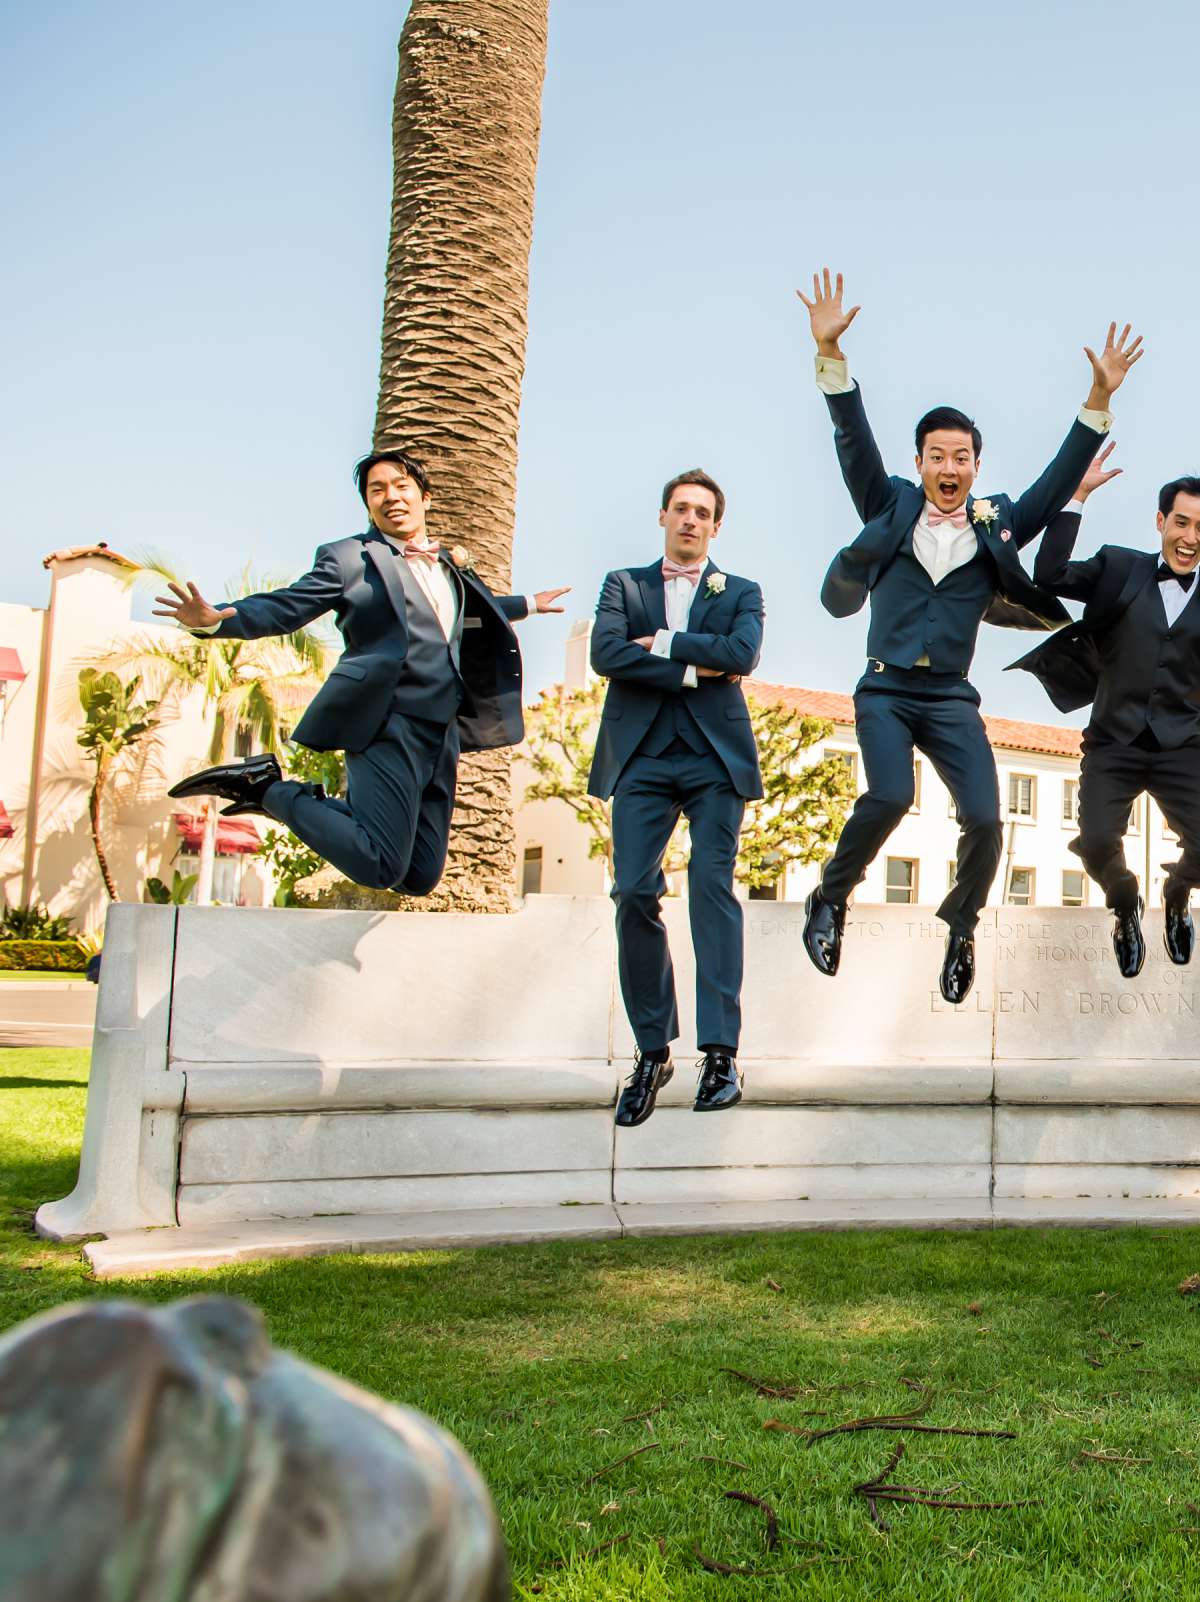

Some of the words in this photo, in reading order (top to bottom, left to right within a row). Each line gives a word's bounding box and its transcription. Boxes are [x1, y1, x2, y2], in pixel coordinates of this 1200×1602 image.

[857, 921, 884, 937] TO
[905, 922, 947, 938] THE
[983, 923, 1052, 939] EOPLE
[1073, 924, 1101, 940] OF
[999, 945, 1016, 960] IN
[1037, 946, 1110, 962] HONOR
[1163, 970, 1192, 985] OF
[929, 990, 1040, 1015] ELLEN
